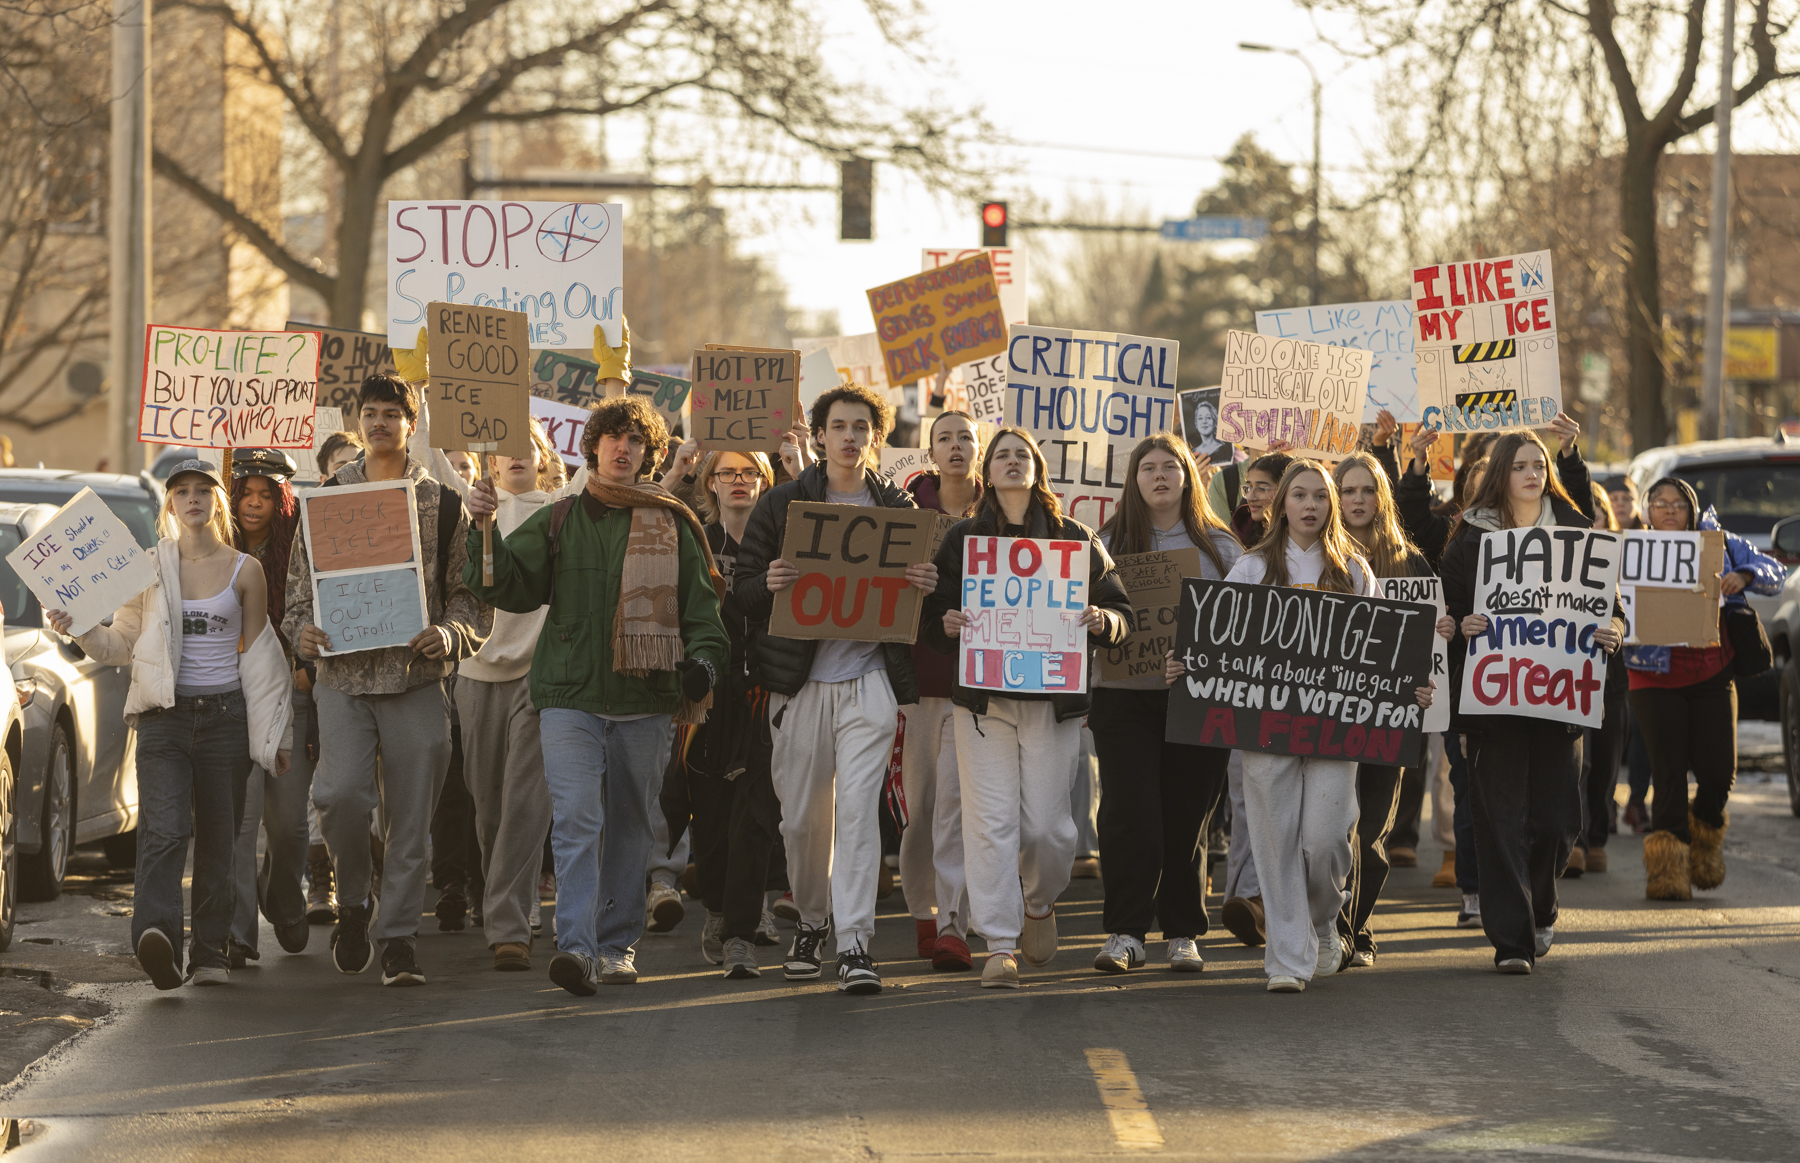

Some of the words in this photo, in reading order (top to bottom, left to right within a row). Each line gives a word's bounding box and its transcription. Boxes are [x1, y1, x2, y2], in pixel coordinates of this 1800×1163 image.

[564, 282, 623, 320] Our
[1413, 265, 1444, 311] I
[1447, 259, 1516, 306] LIKE
[440, 308, 507, 340] RENEE
[878, 303, 936, 343] GIVES
[943, 282, 998, 318] SMALL
[1262, 312, 1298, 338] I
[1418, 308, 1463, 341] MY
[1505, 298, 1551, 336] ICE
[447, 339, 518, 376] GOOD
[886, 332, 941, 381] DICK
[940, 309, 1002, 356] ENERGY
[1008, 335, 1174, 390] CRITICAL
[1228, 331, 1267, 365] NO
[1271, 339, 1320, 370] ONE
[1326, 346, 1362, 378] IS
[154, 370, 205, 405] BUT
[210, 375, 242, 406] YOU
[245, 378, 317, 407] SUPPORT
[696, 356, 748, 382] HOT
[754, 357, 794, 383] PPL
[440, 382, 482, 405] ICE
[714, 388, 772, 412] MELT
[1224, 366, 1316, 403] ILLEGAL
[1318, 377, 1358, 414] ON
[229, 405, 276, 443] WHO
[461, 411, 507, 441] BAD
[704, 416, 769, 441] ICE
[1007, 383, 1174, 438] THOUGHT
[1221, 402, 1312, 449] STOLEN
[1307, 408, 1358, 455] LAND
[1422, 396, 1558, 432] CRUSHED
[23, 534, 62, 571] ICE
[795, 510, 917, 568] ICE
[967, 537, 1083, 579] HOT
[1484, 526, 1617, 590] HATE
[1133, 566, 1157, 577] SAFE
[1164, 563, 1179, 575] AT
[1622, 538, 1697, 584] OUR
[41, 576, 54, 586] in
[336, 579, 386, 596] ICE
[791, 572, 911, 629] OUT
[963, 576, 1084, 610] PEOPLE
[1385, 578, 1438, 601] ABOUT
[1486, 583, 1553, 611] doesn't
[1556, 589, 1608, 617] make
[962, 608, 1083, 649] MELT
[1189, 584, 1254, 646] YOU
[1340, 601, 1420, 672] GET
[974, 650, 1067, 688] ICE
[1182, 647, 1209, 671] to
[1271, 659, 1326, 687] about
[1472, 653, 1601, 717] Great
[1186, 675, 1264, 710] WHEN
[1269, 685, 1291, 711] U
[1297, 687, 1373, 725] VOTED
[1375, 700, 1420, 729] FOR
[1199, 707, 1238, 746] A
[1258, 710, 1405, 763] FELON
